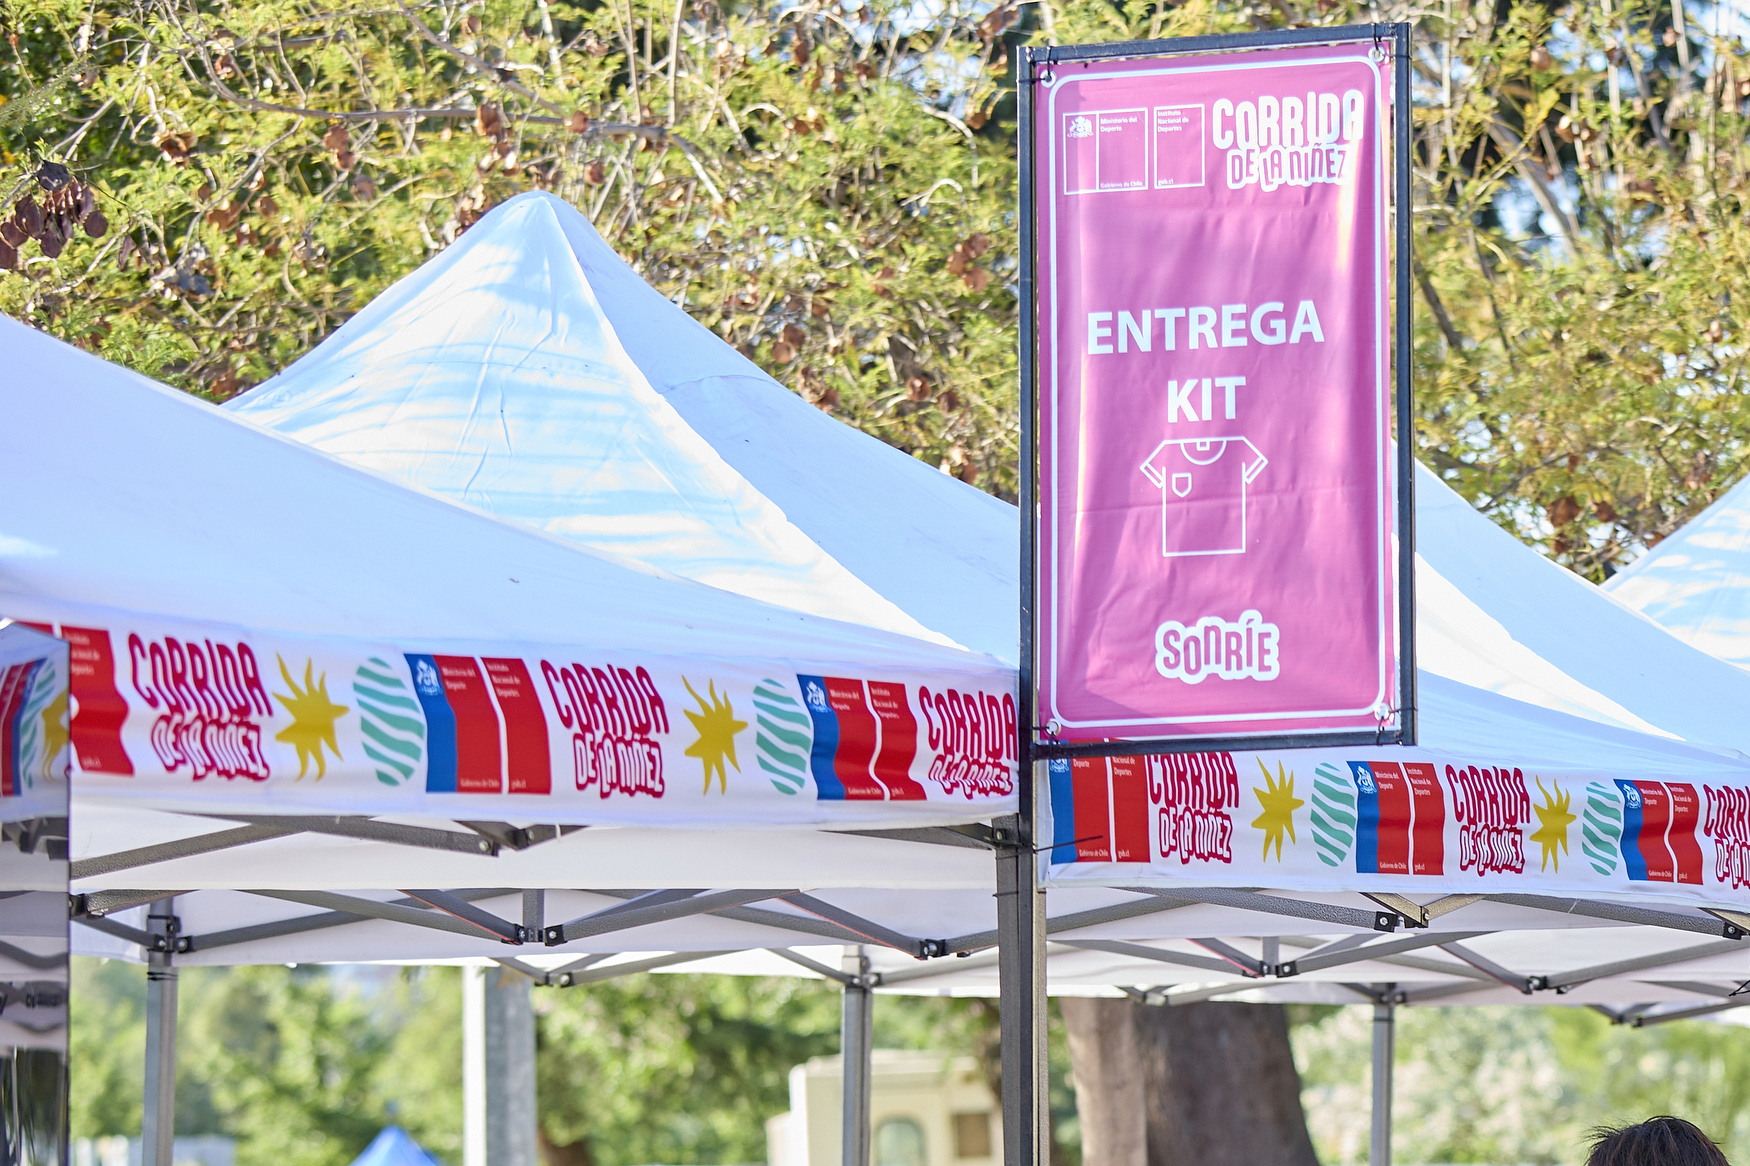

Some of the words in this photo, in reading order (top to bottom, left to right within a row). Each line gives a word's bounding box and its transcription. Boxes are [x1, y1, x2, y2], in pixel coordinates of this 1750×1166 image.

[1100, 116, 1128, 125] Ministerio
[1157, 117, 1182, 125] Nacional
[1213, 90, 1364, 150] CORRIDA
[1157, 178, 1174, 186] gob.cl
[1227, 147, 1259, 189] DE
[1259, 145, 1286, 192] LA
[1087, 300, 1325, 355] ENTREGA
[1167, 376, 1247, 423] KIT
[128, 633, 273, 717] CORRIDA
[1158, 613, 1277, 681] SONRÍE
[540, 660, 669, 736] CORRIDA
[919, 686, 1018, 762] CORRIDA
[152, 714, 187, 771] DE
[180, 715, 214, 781] LA
[573, 732, 598, 790] DE
[597, 732, 617, 799] LA
[928, 754, 953, 795] DE
[950, 754, 973, 799] LA
[1150, 752, 1239, 809] CORRIDA
[1445, 764, 1530, 827] CORRIDA
[1159, 805, 1178, 858] DE
[1177, 806, 1194, 864] LA
[1459, 825, 1476, 871] DE
[1475, 823, 1492, 876] LA
[1715, 837, 1730, 883] DE
[1729, 838, 1744, 890] LA
